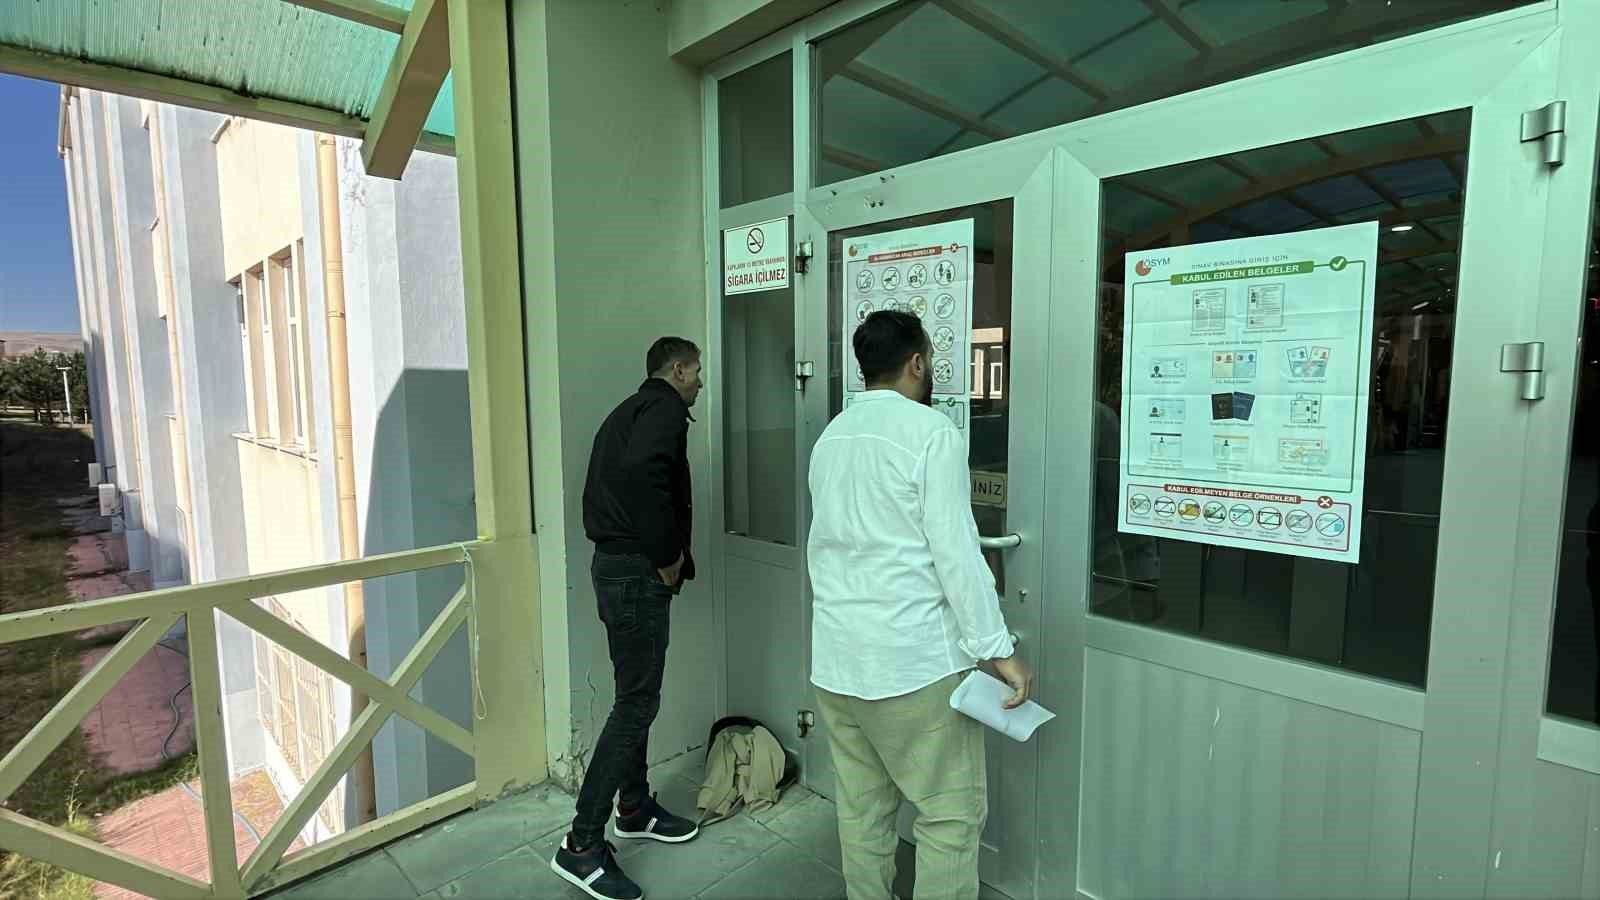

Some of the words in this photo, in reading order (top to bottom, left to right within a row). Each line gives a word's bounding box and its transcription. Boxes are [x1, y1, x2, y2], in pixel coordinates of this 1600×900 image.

[728, 272, 754, 288] SİGARA
[1182, 273, 1212, 284] KABUL
[1247, 264, 1301, 277] BELGELER
[1167, 485, 1190, 494] KABUL
[1228, 491, 1254, 500] BELGE
